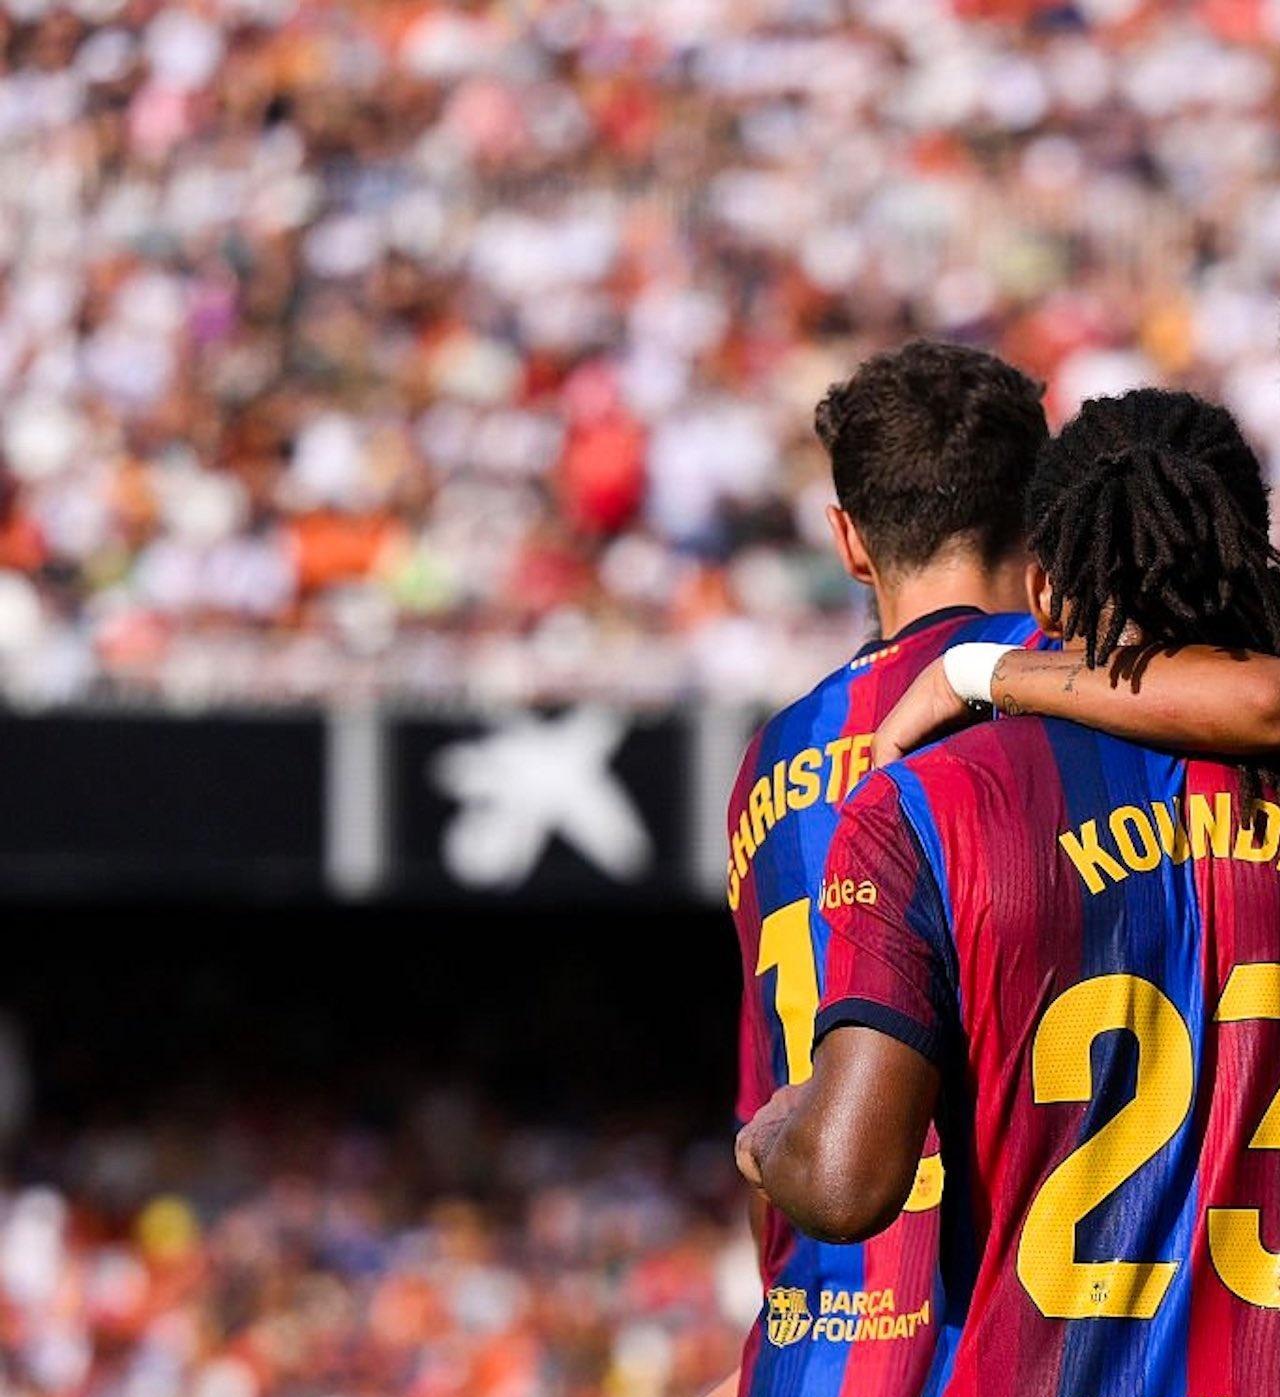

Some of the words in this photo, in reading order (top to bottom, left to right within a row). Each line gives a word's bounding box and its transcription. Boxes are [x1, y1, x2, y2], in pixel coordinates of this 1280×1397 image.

[727, 732, 875, 912] CHRISTE
[818, 873, 877, 911] idea
[811, 1300, 930, 1342] FOUNDATN
[819, 1288, 896, 1318] BARÇA
